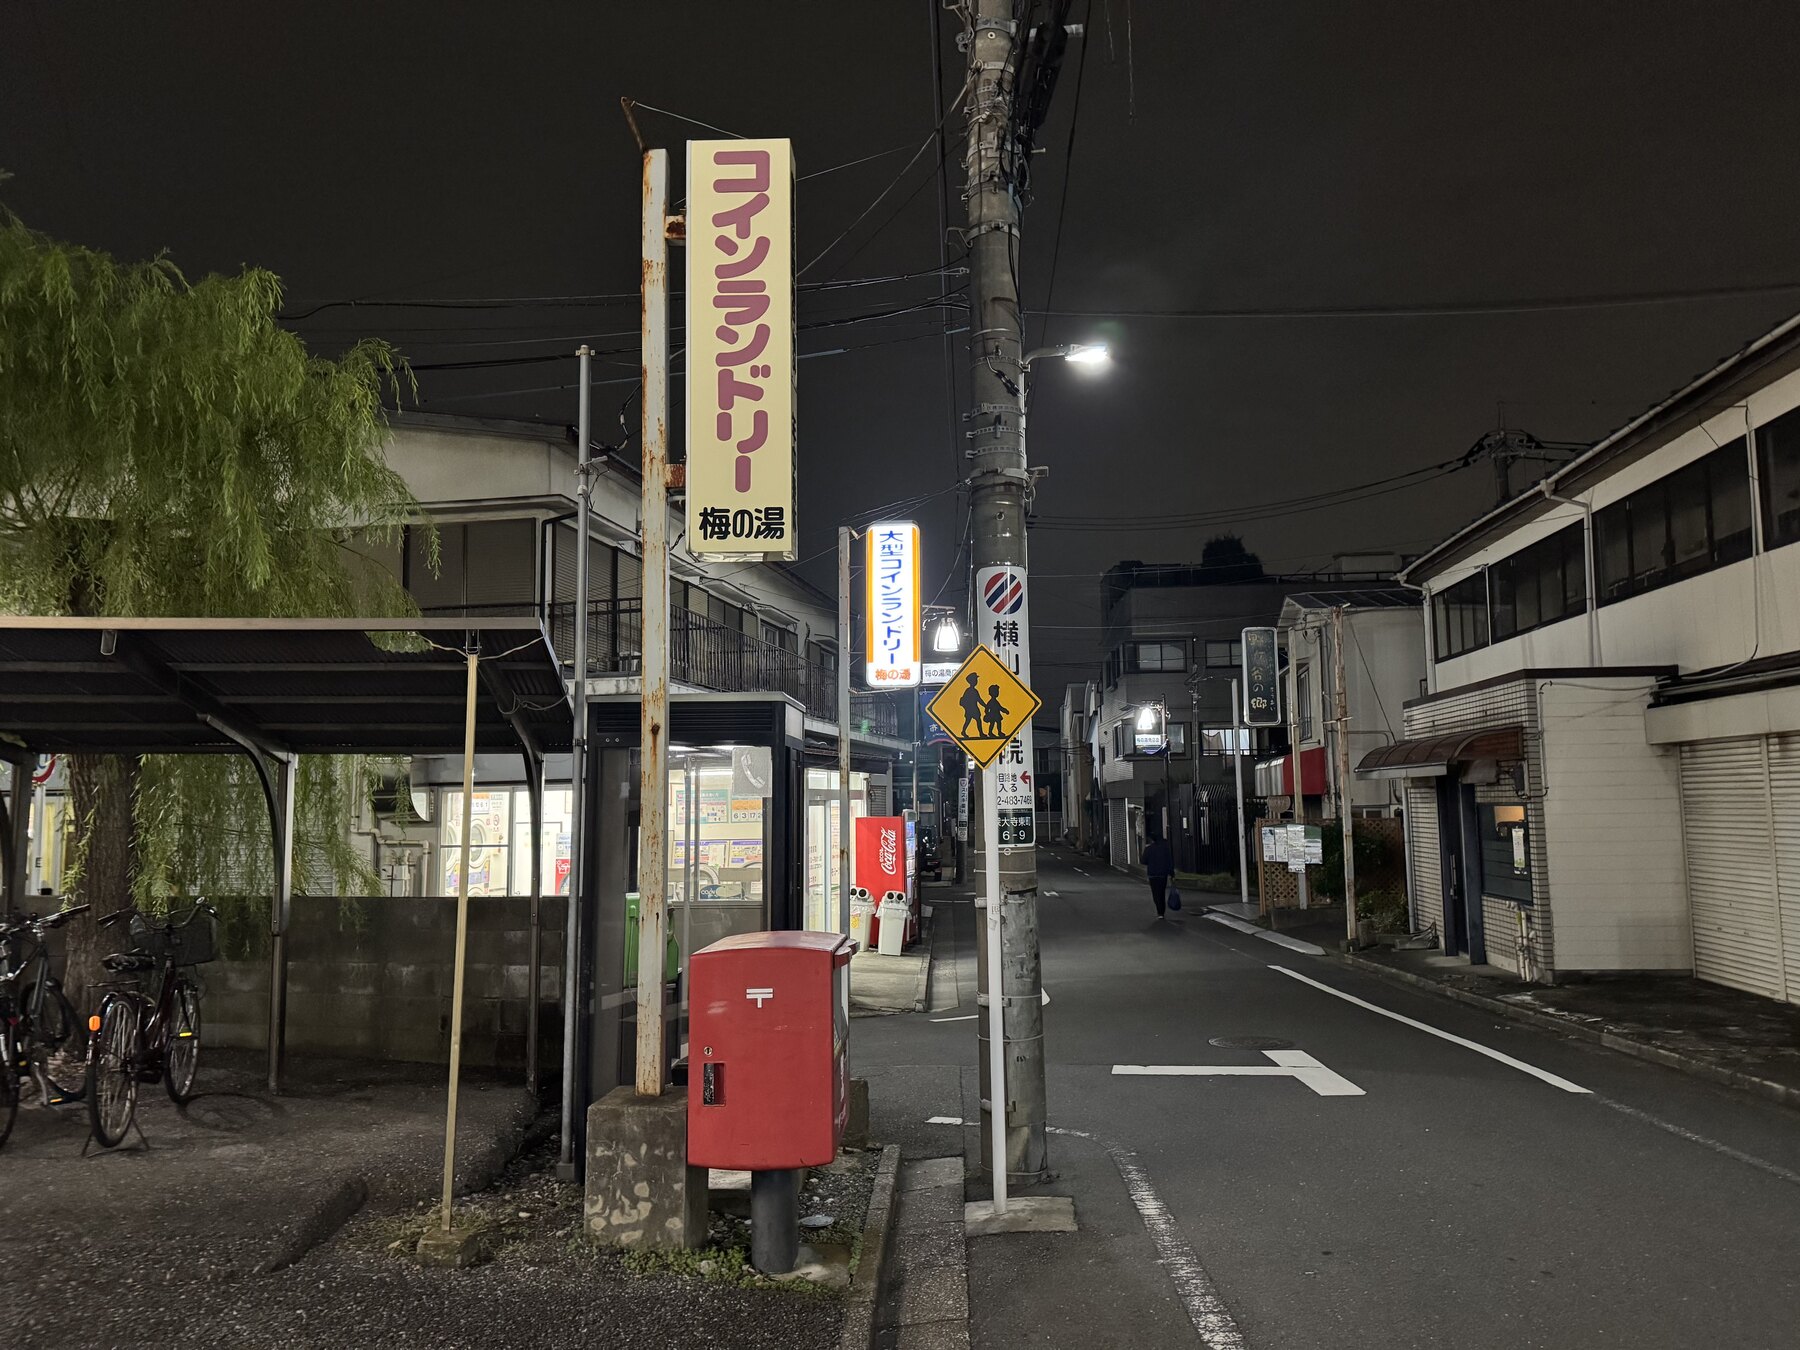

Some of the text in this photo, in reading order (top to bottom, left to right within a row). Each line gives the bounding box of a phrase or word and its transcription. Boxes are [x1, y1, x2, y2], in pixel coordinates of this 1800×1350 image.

[712, 150, 770, 493] コインランドリー
[700, 506, 785, 540] 梅の湯
[879, 530, 904, 665] 大型コインランドリー
[875, 668, 912, 681] 梅の湯
[998, 783, 1018, 793] 入る
